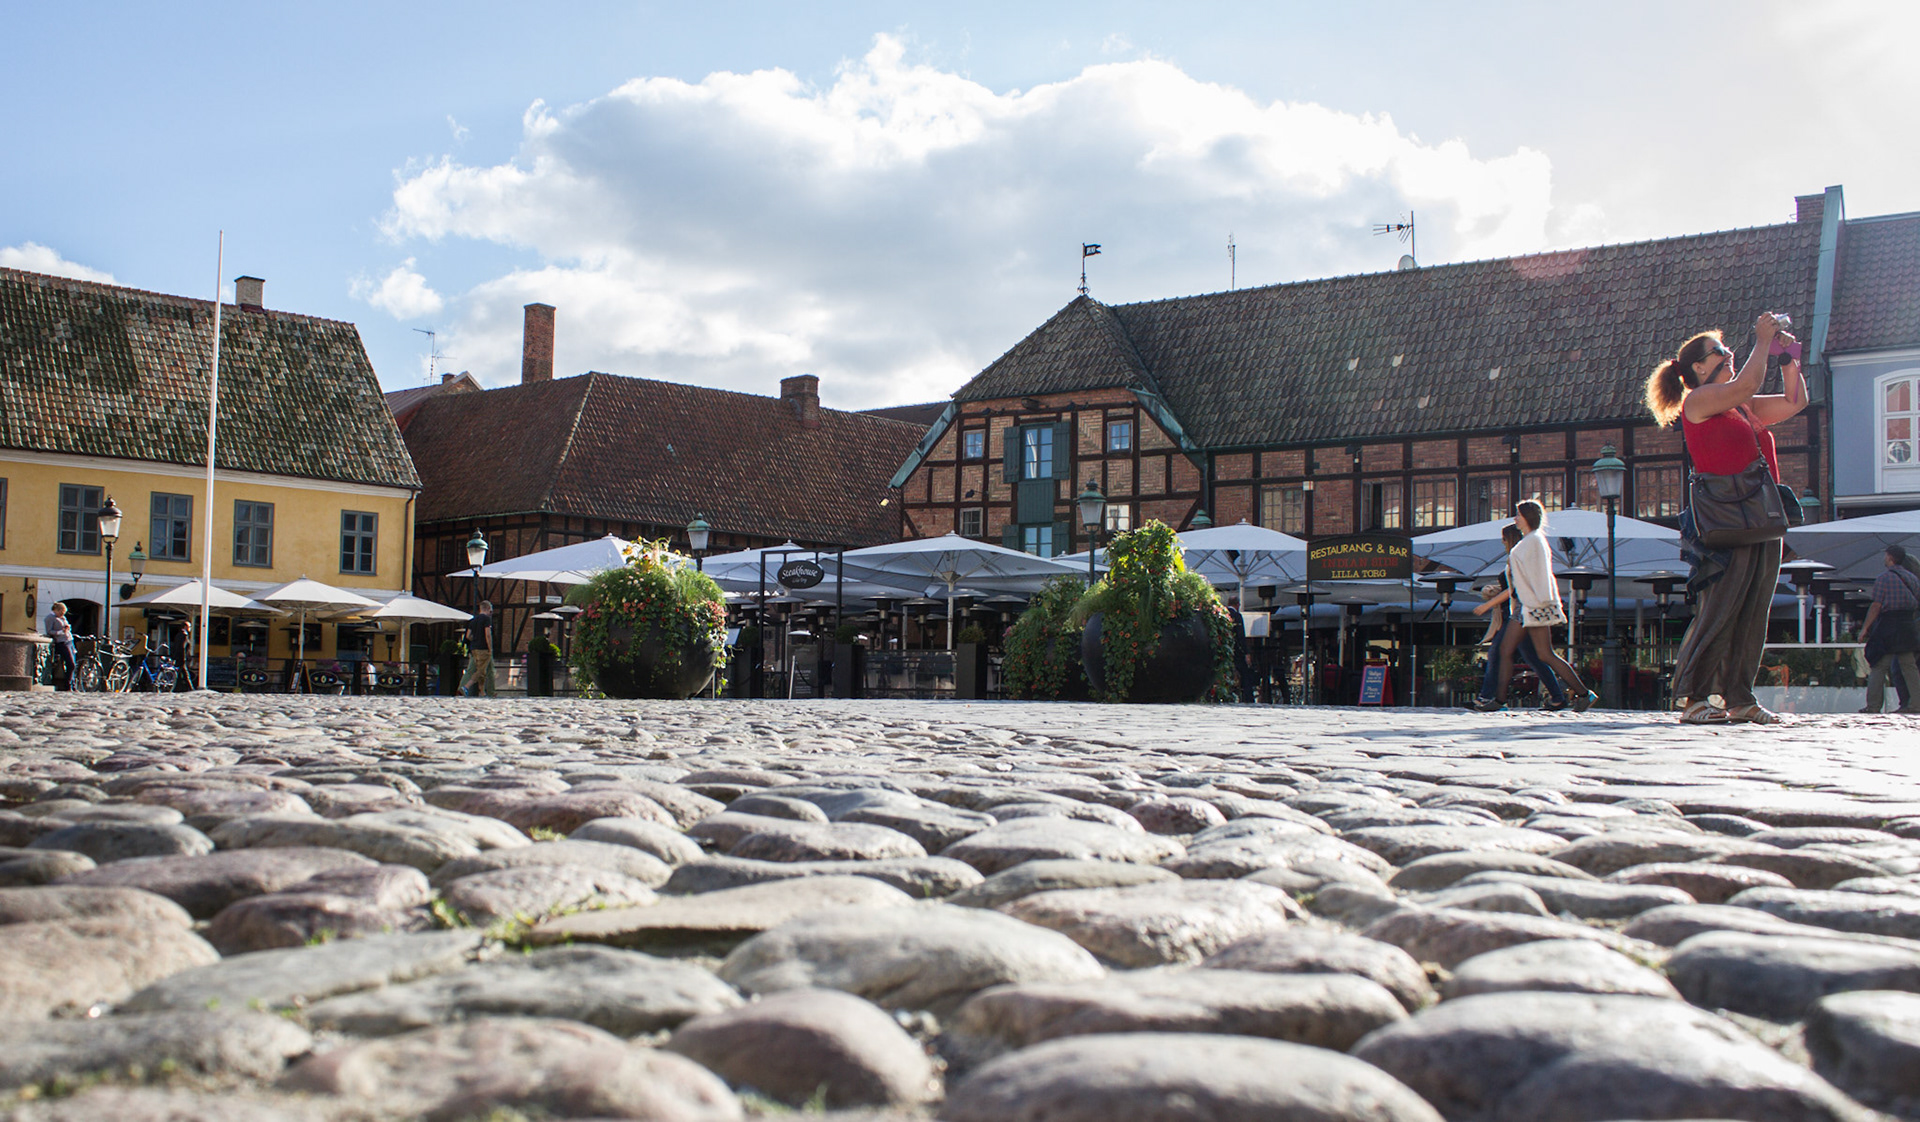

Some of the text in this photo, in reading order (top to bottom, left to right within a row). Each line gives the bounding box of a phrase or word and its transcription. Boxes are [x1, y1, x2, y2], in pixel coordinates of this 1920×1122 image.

[1311, 542, 1408, 560] RESTAURANG & BAR
[1321, 557, 1399, 568] INDIAN SIDE
[1331, 569, 1387, 578] LILLA TORG
